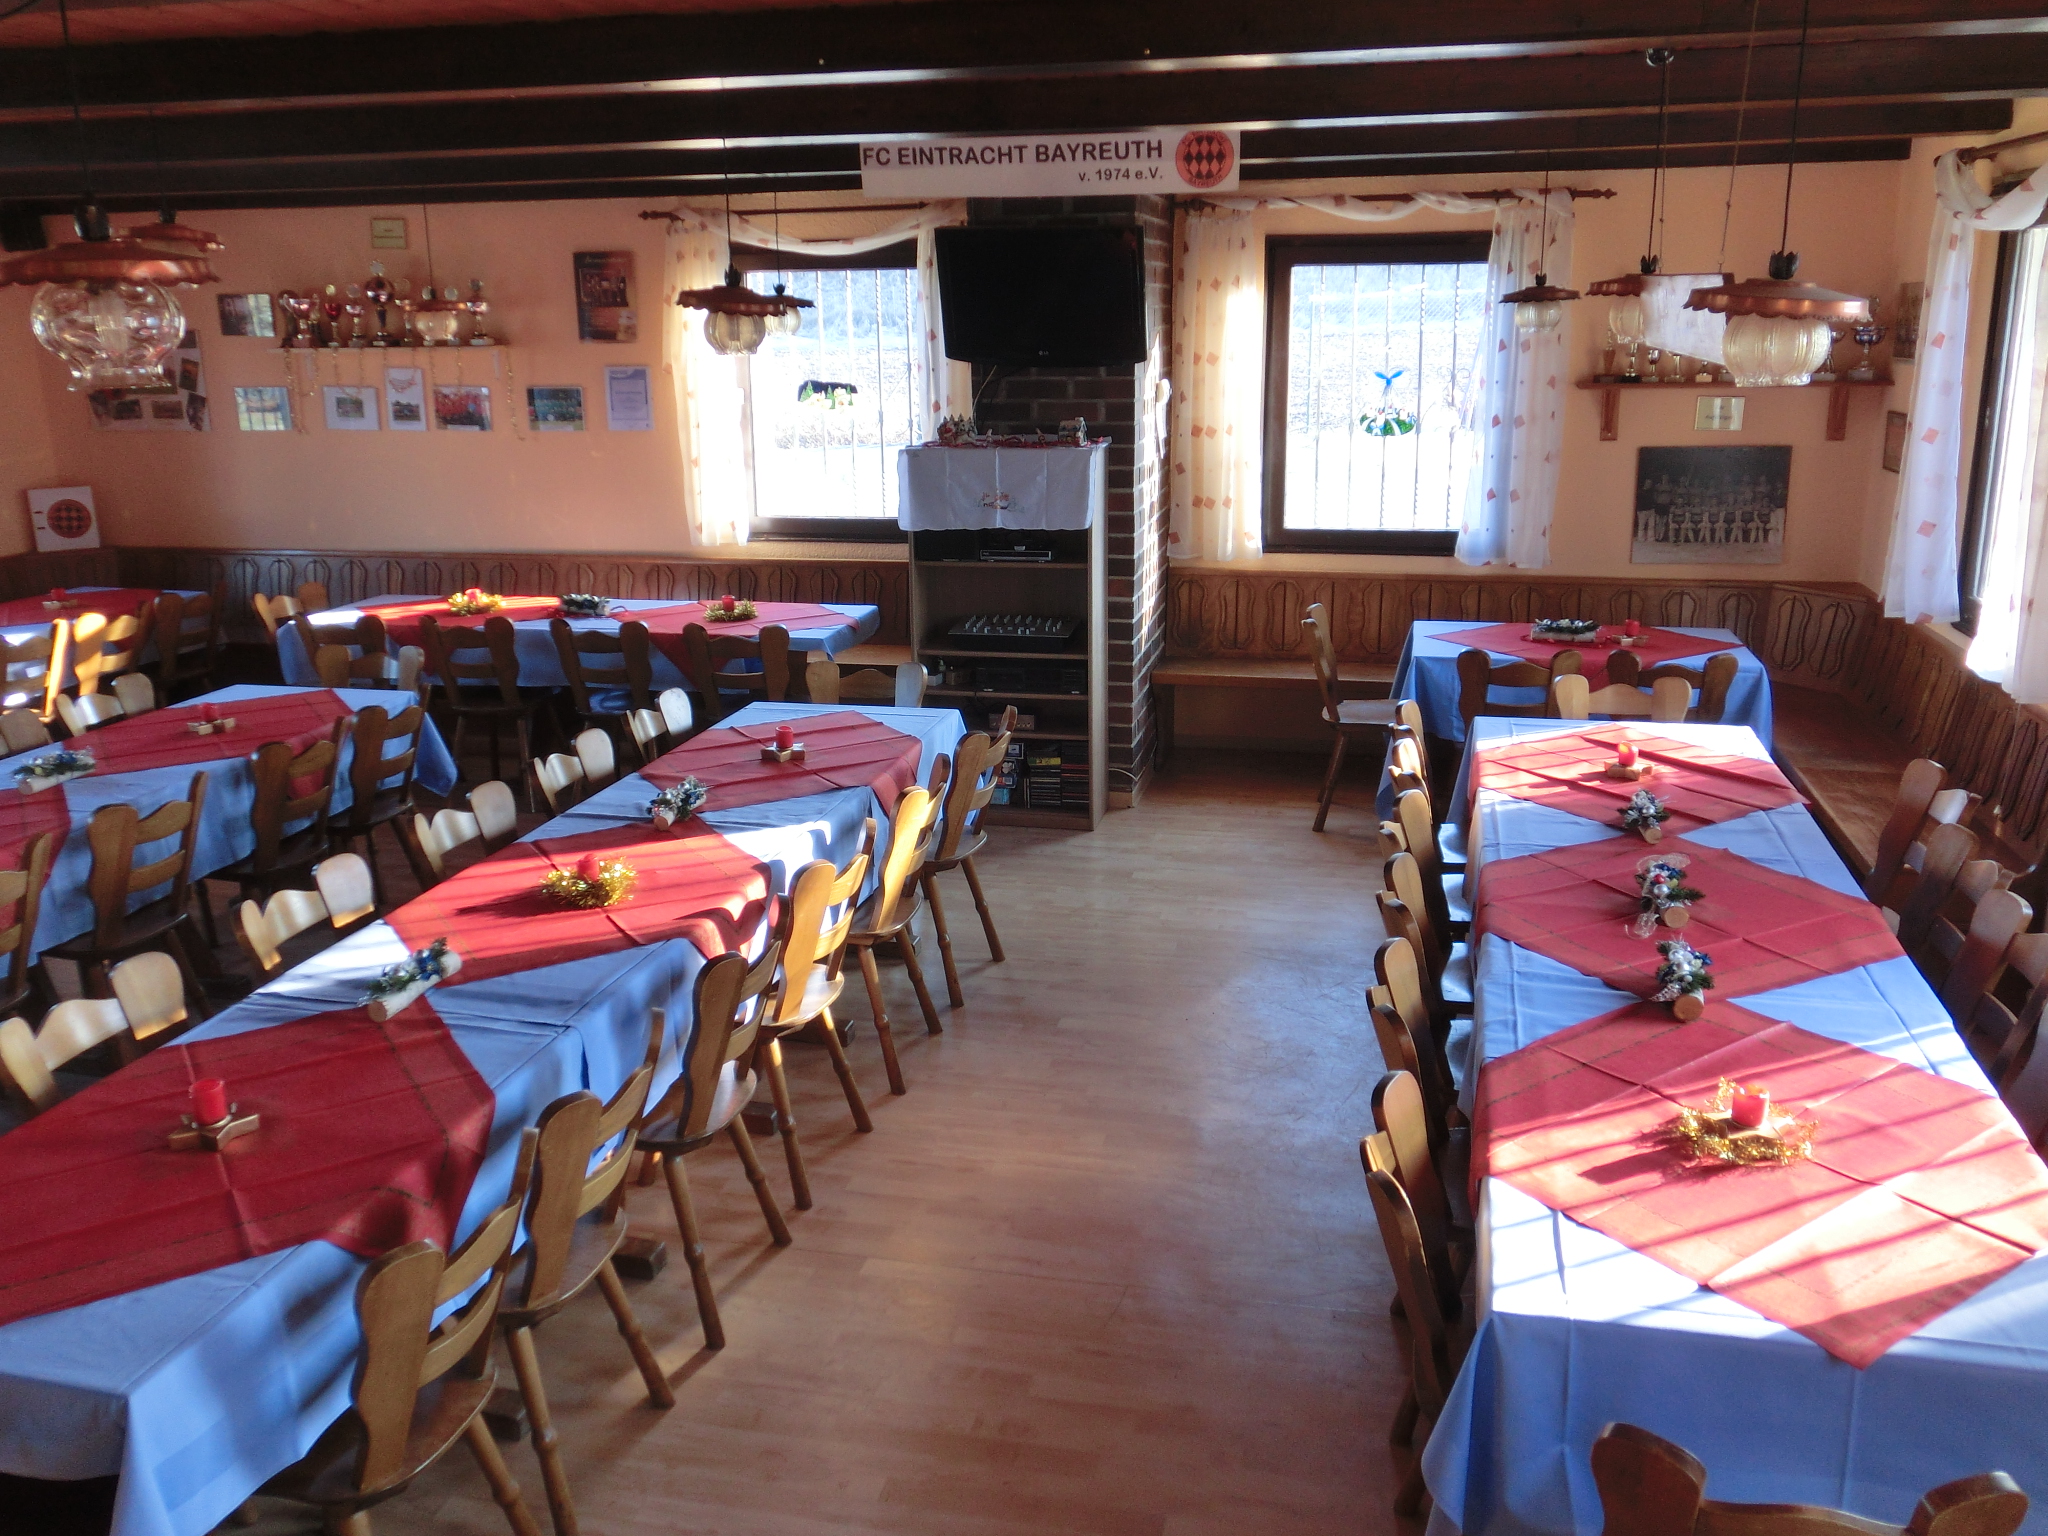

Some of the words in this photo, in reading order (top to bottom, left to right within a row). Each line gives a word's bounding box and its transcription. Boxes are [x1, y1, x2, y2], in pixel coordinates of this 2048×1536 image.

[863, 147, 891, 166] FC
[897, 145, 1028, 166] EINTRACHT
[1035, 139, 1163, 163] BAYREUTH
[1078, 172, 1091, 182] v.
[1095, 167, 1131, 181] 1974
[1135, 166, 1163, 180] e.V.
